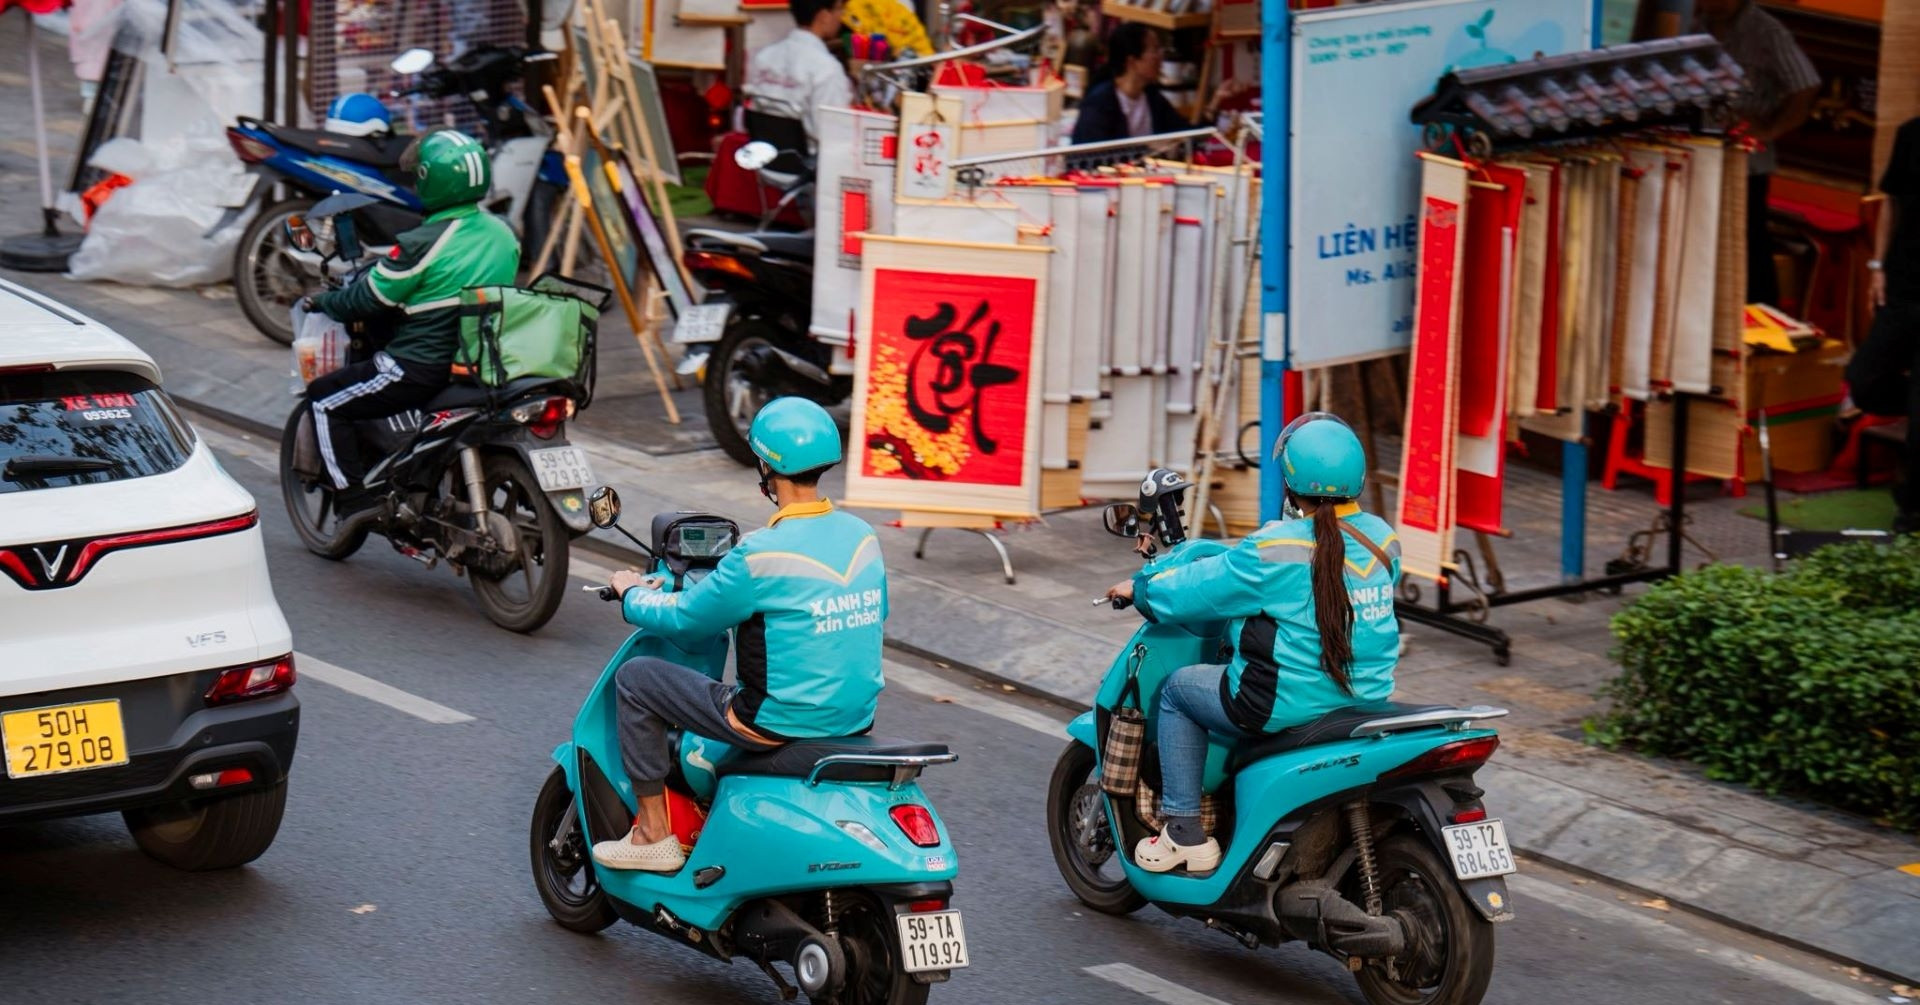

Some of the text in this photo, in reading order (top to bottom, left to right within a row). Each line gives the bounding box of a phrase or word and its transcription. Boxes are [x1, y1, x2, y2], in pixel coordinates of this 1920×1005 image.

[1318, 214, 1417, 259] LIÊN HỆ
[1346, 268, 1376, 286] Ms.
[61, 393, 137, 411] XE TAXI
[82, 408, 132, 421] 093625
[540, 450, 580, 469] 59-C1
[809, 588, 882, 617] XANH SM
[815, 606, 881, 634] xin chào!
[38, 708, 89, 738] 50H
[22, 736, 113, 771] 279.08
[1452, 824, 1499, 851] 59-T2
[1456, 847, 1510, 875] 684.65
[907, 915, 955, 941] 59-TA
[908, 940, 964, 968] 119.92
